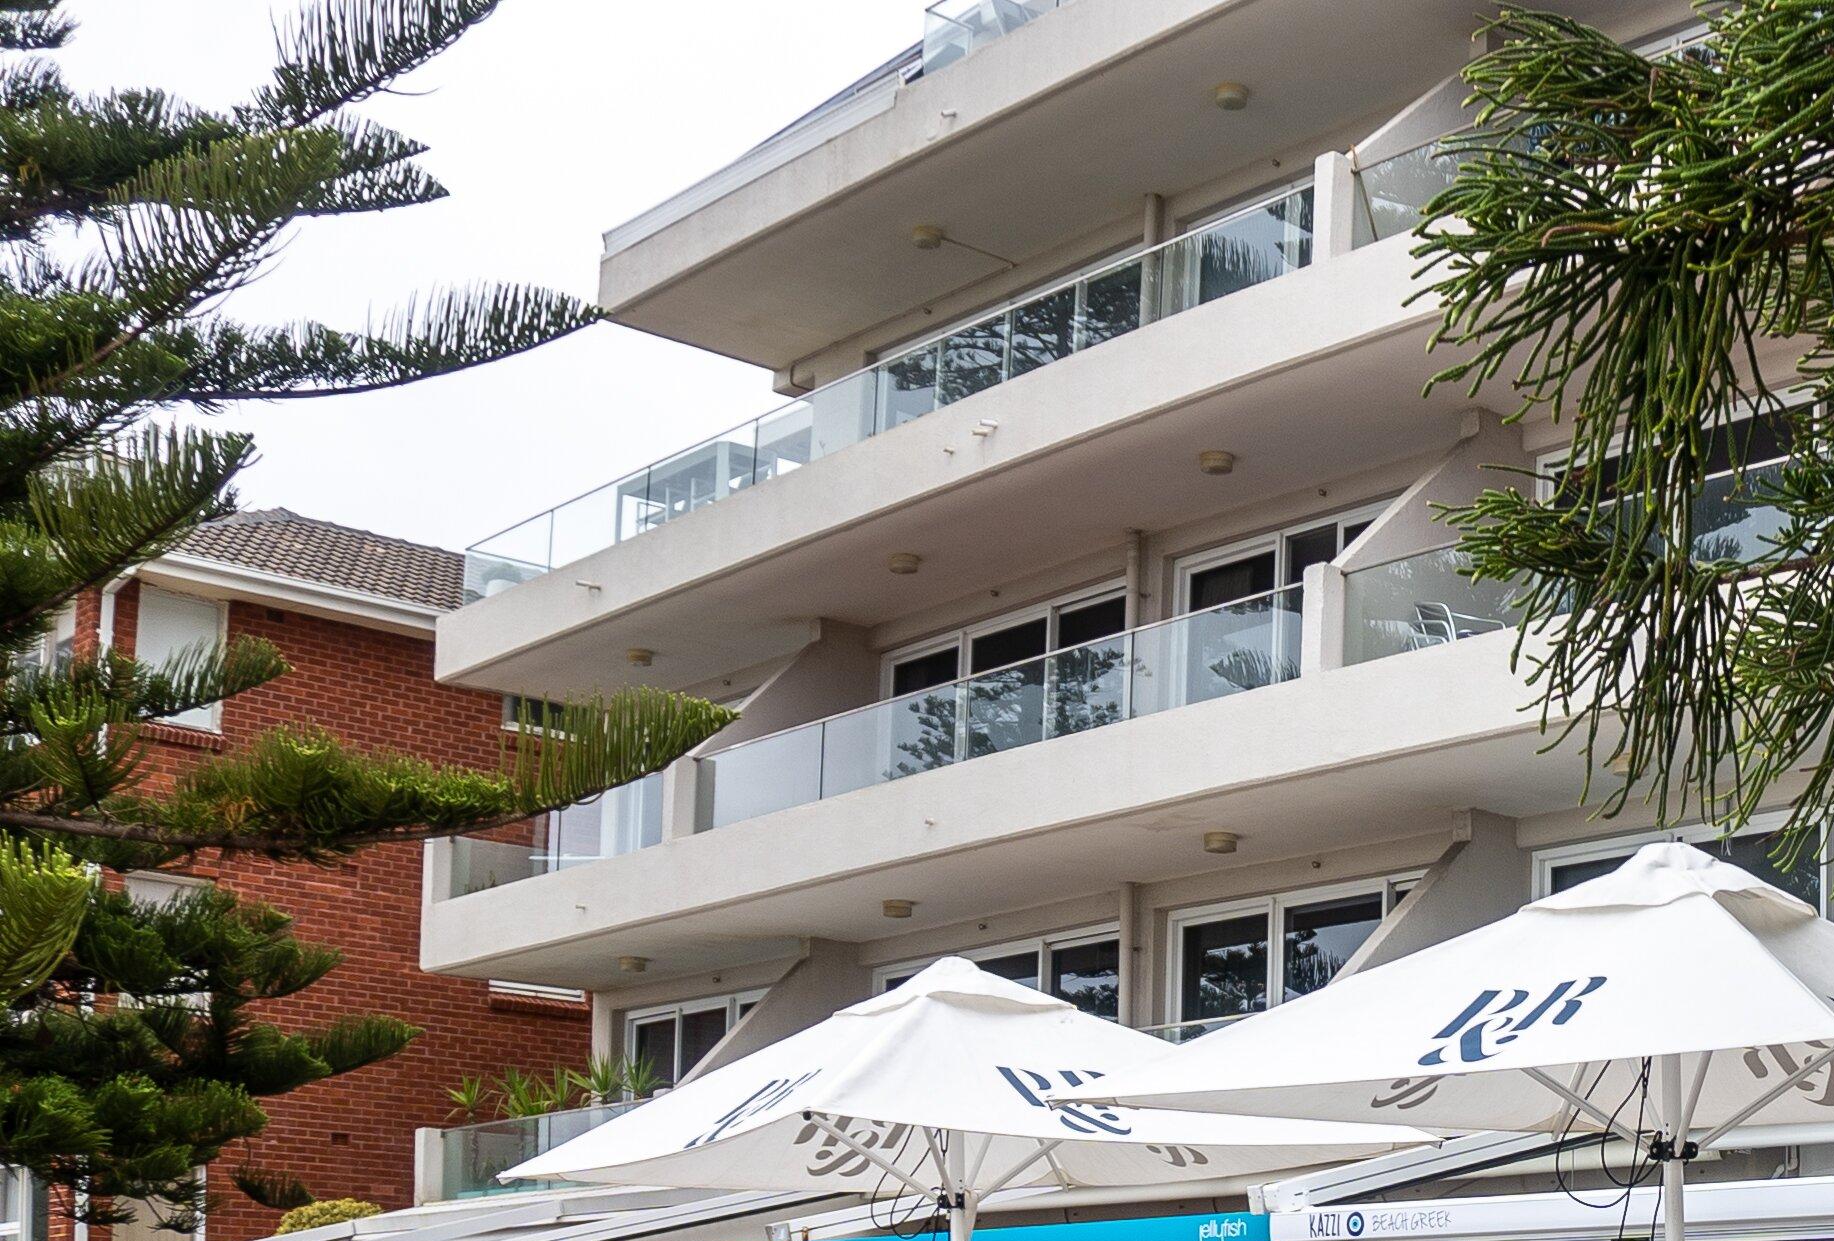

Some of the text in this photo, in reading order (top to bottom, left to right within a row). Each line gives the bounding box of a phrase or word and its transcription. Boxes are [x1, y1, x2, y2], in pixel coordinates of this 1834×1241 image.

[1309, 1210, 1452, 1238] KAZZI BEACH GREEK
